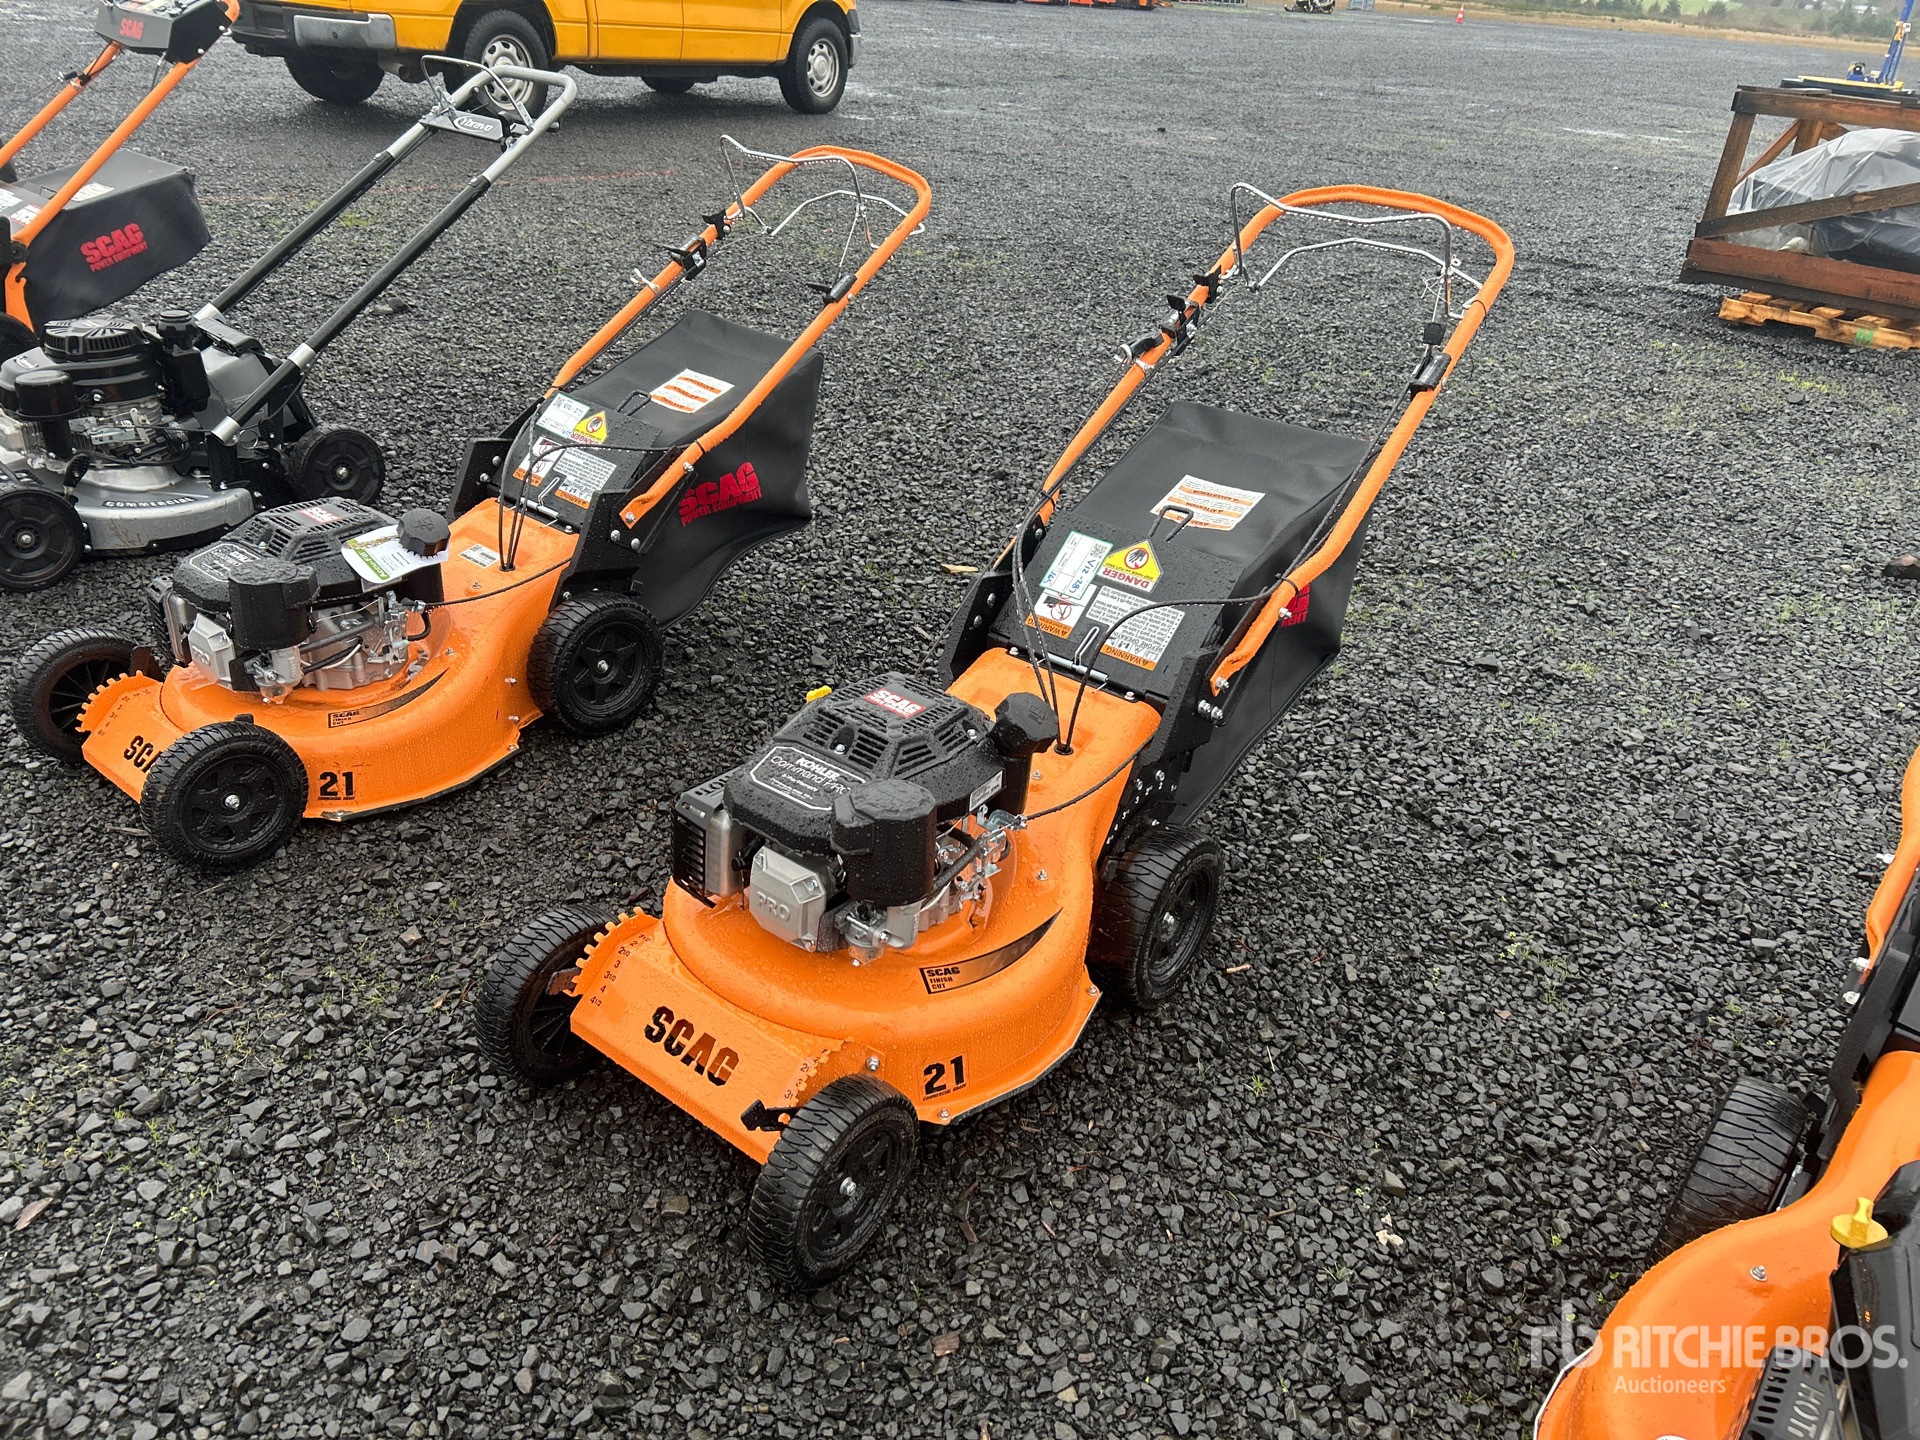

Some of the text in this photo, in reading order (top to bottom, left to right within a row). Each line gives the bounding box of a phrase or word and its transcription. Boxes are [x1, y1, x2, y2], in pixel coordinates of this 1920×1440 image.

[119, 18, 144, 41] SCAG
[80, 223, 144, 264] SCAG
[678, 461, 759, 516] SCAG
[103, 496, 193, 508] COMMERCIAL
[681, 486, 762, 527] POWER EQUIPMENT
[359, 550, 388, 577] Accu-Fill
[1102, 567, 1150, 589] DANGER
[1105, 646, 1142, 665] WARNING
[332, 710, 360, 718] SCAG
[872, 690, 922, 714] SCAG
[123, 735, 162, 773] SC
[770, 755, 826, 784] Command
[319, 771, 354, 796] 21
[756, 890, 791, 921] PRO
[613, 960, 621, 968] 3
[926, 966, 961, 977] SCAG
[600, 985, 607, 993] 4
[929, 976, 954, 984] FINISH
[644, 1005, 740, 1087] SCAG
[923, 1055, 965, 1096] 21
